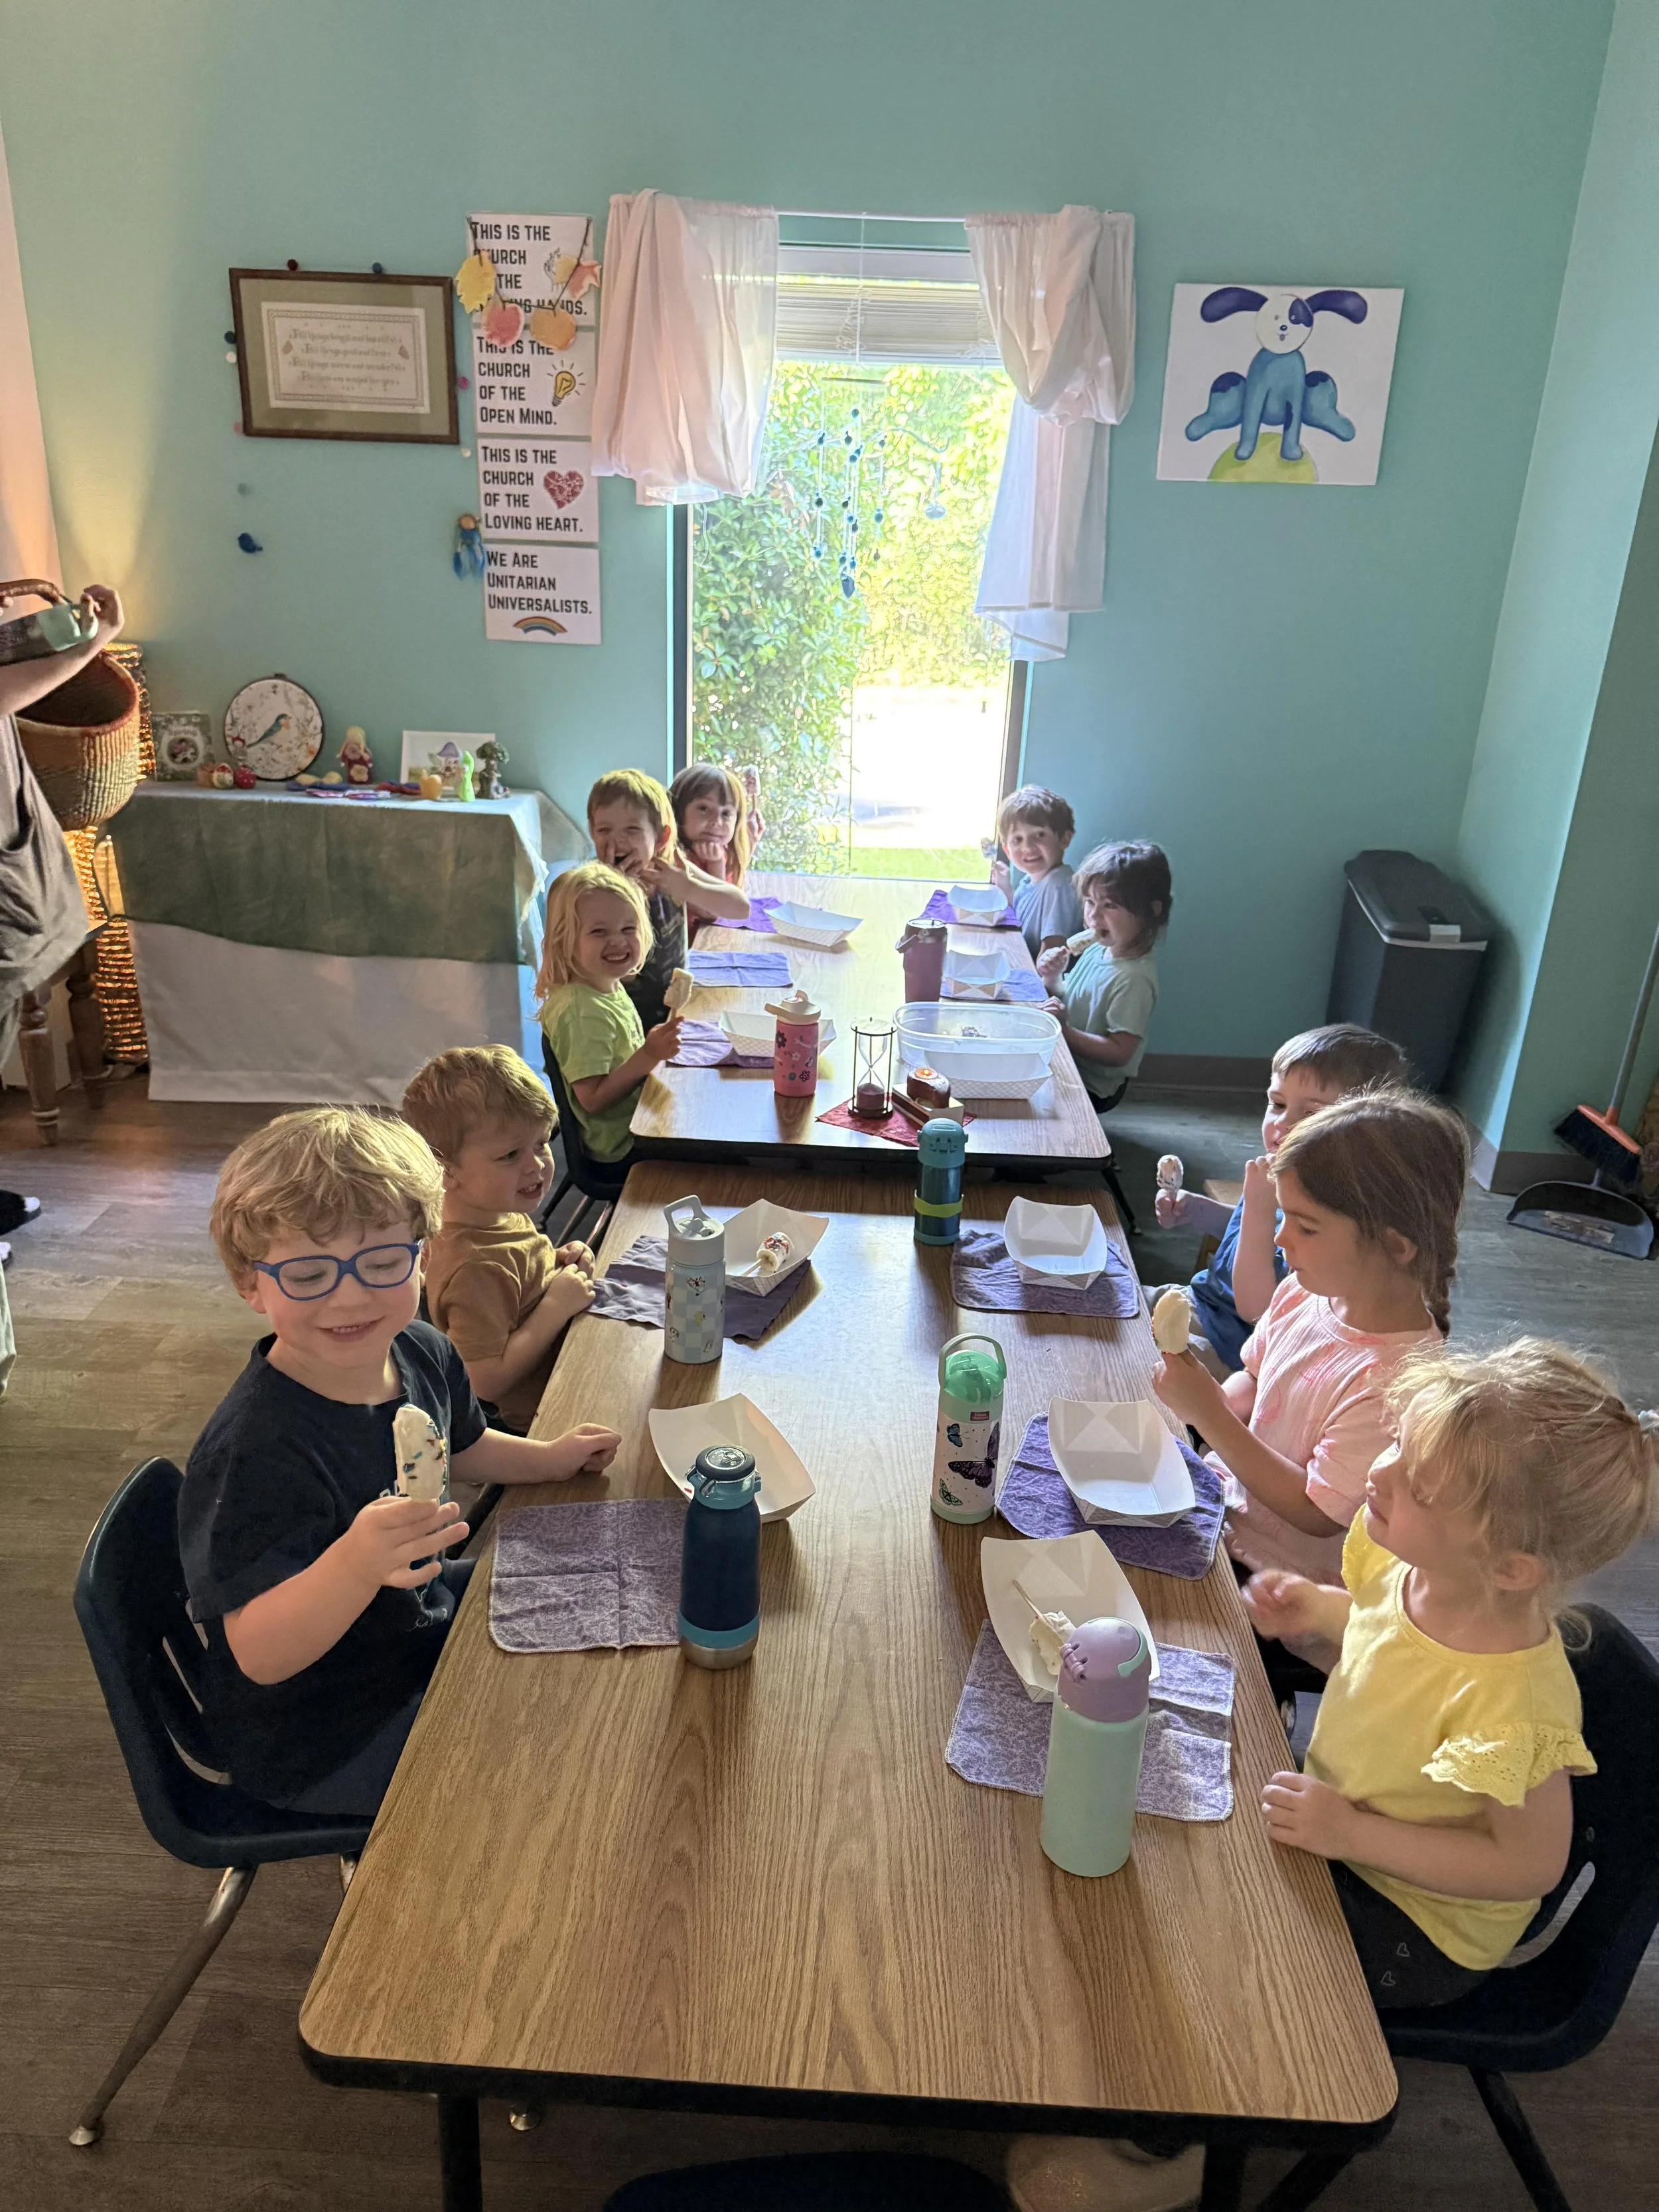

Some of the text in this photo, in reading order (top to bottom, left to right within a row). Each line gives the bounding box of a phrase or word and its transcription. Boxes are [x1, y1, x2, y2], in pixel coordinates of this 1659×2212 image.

[470, 221, 551, 242] THIS IS THE
[474, 248, 526, 265] URCH
[497, 273, 522, 290] THE
[511, 339, 524, 354] IS
[478, 362, 530, 378] CHURCH
[479, 385, 526, 402] OF THE
[480, 406, 557, 425] OPEN MIND.
[482, 445, 557, 465] THIS IS THE
[483, 470, 534, 486] CHURCH
[484, 492, 530, 508] OF THE
[484, 512, 583, 533] LOVING HEART.
[486, 550, 538, 569] WE ARE
[487, 571, 556, 591] UNITARIAN
[488, 593, 593, 615] UNIVERSALISTS.
